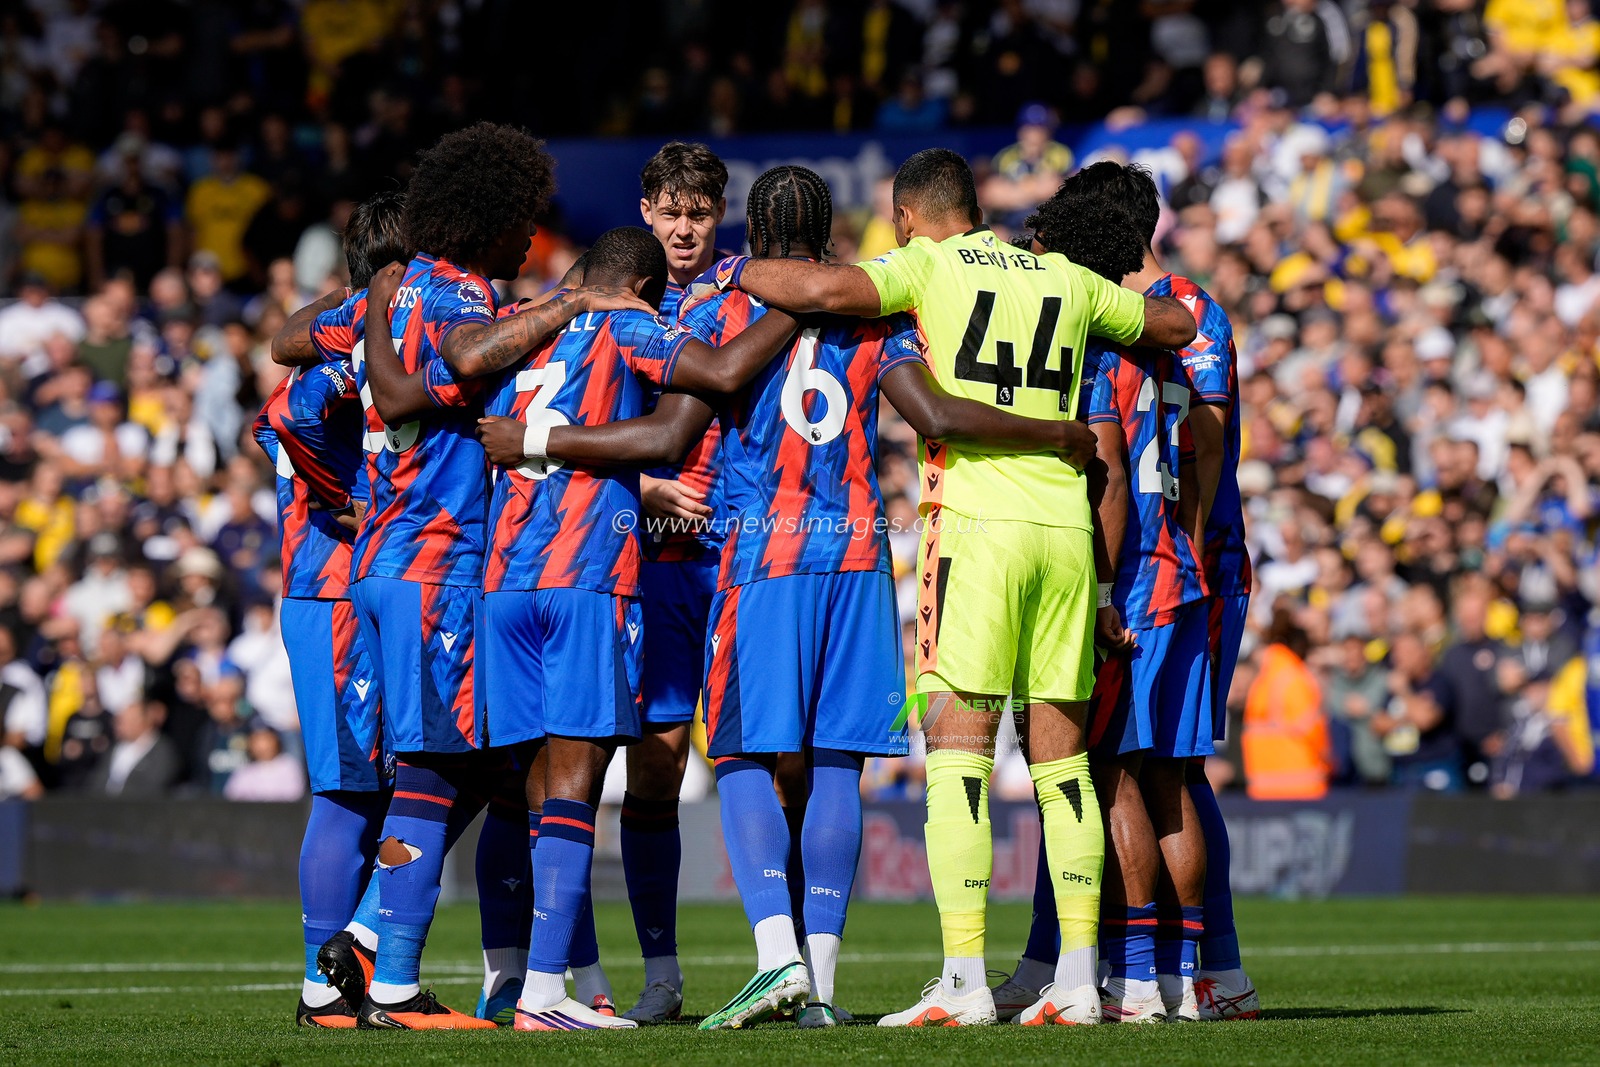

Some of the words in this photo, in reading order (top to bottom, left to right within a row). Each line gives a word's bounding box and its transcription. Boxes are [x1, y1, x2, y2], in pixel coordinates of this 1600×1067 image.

[954, 289, 1074, 413] 44
[781, 326, 848, 446] 6
[763, 869, 787, 882] CPFC
[1062, 871, 1093, 886] CPFC
[964, 878, 990, 889] CPFC
[810, 886, 841, 898] CPFC
